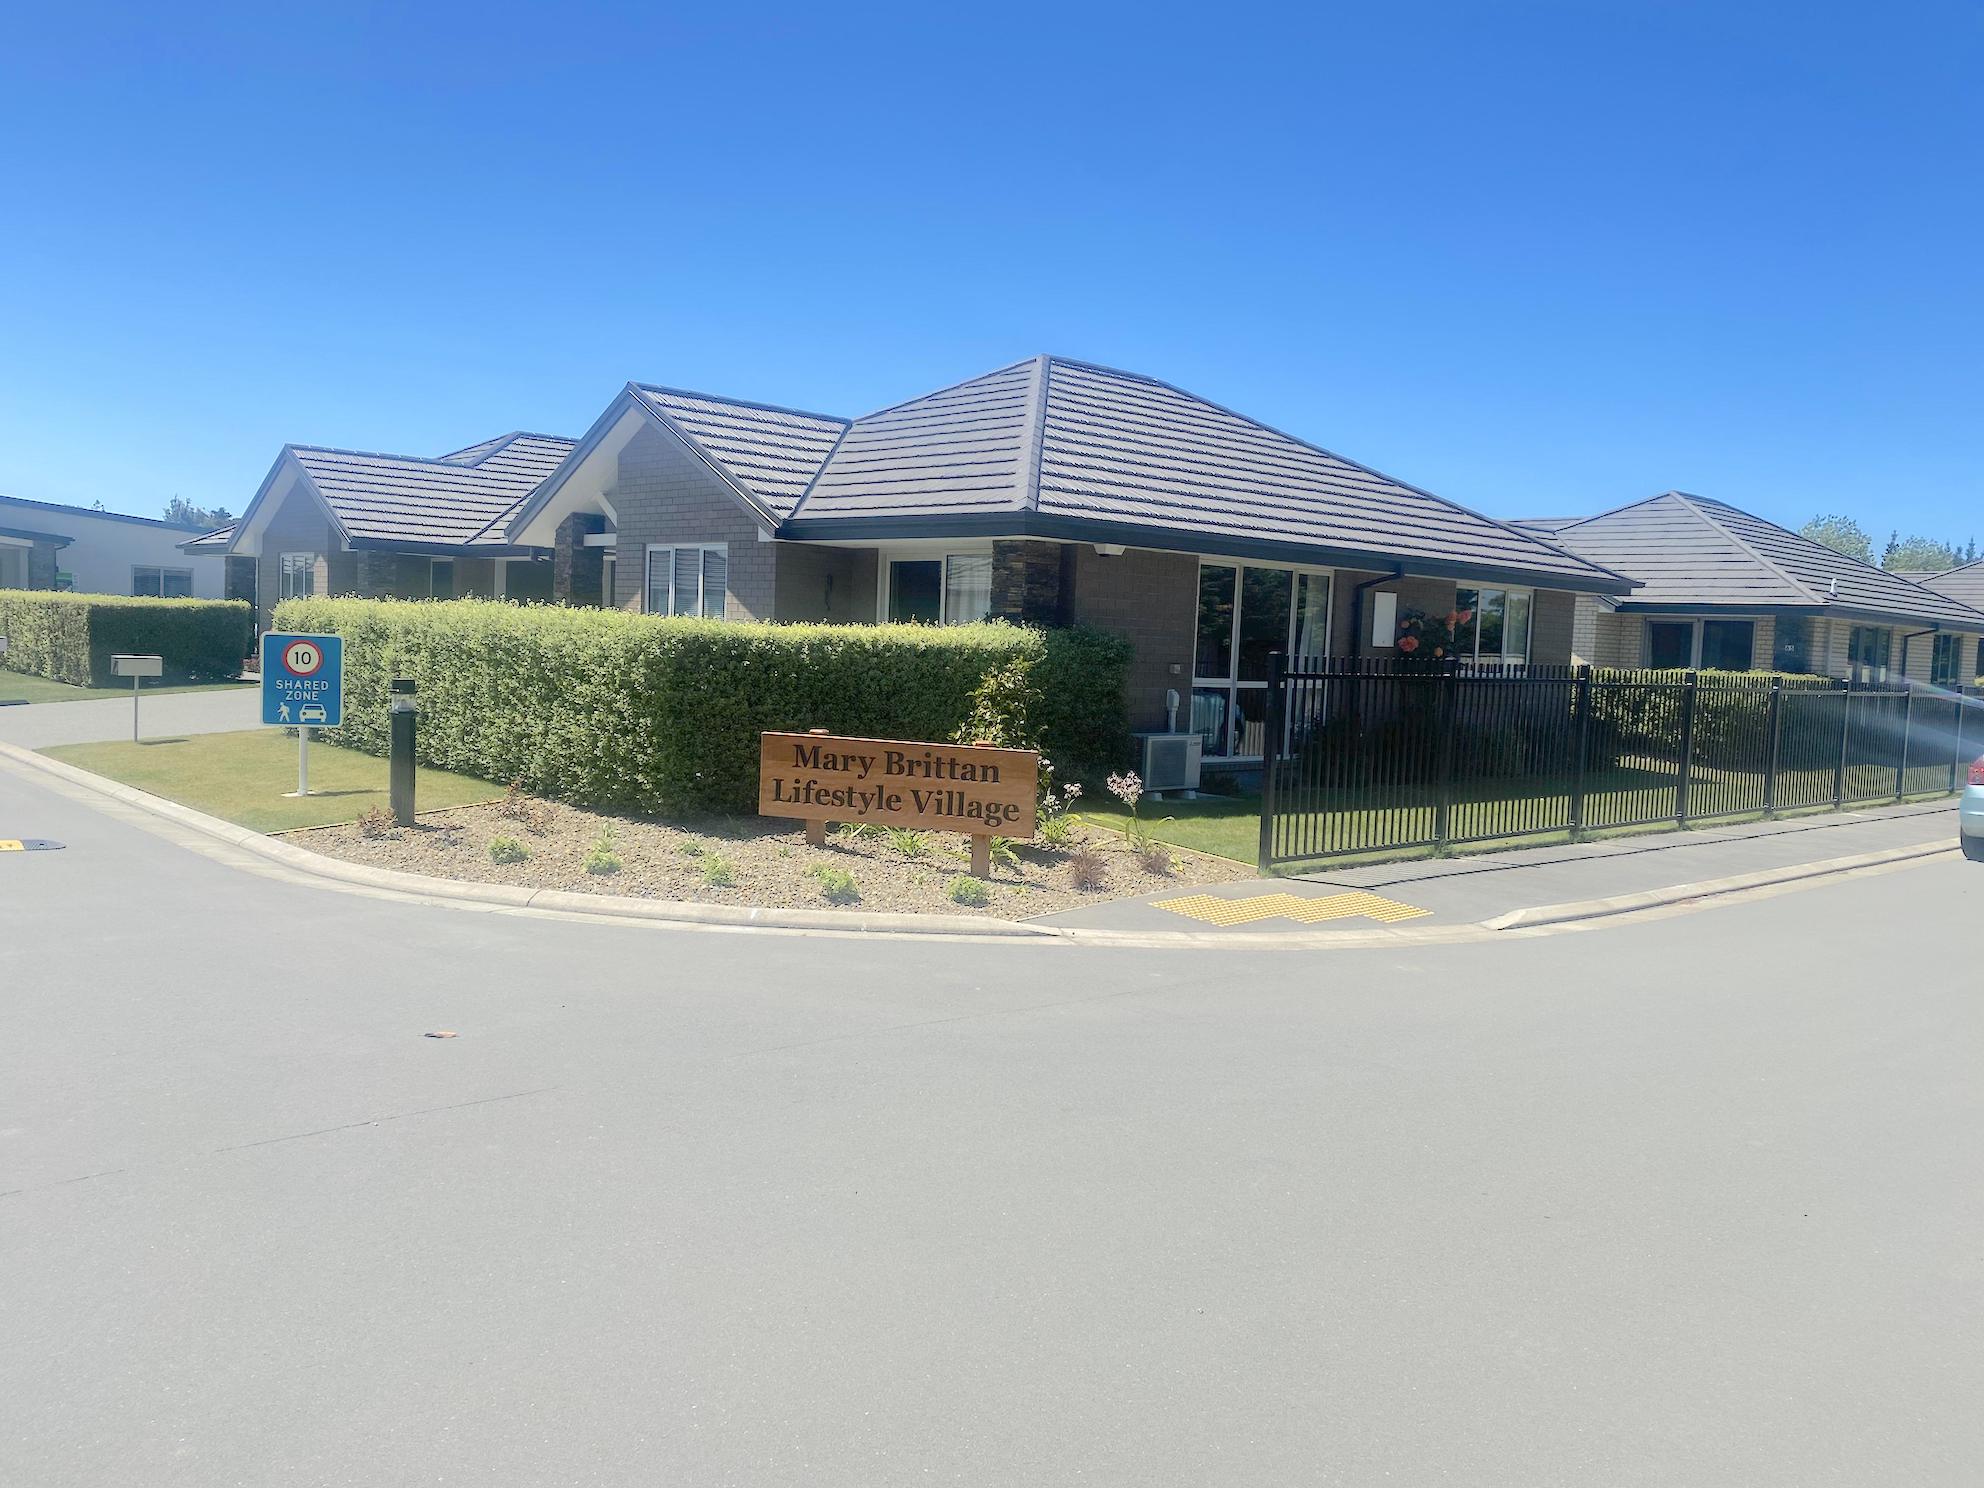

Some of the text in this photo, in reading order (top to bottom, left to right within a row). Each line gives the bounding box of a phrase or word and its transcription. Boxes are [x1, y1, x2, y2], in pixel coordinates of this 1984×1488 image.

[294, 651, 311, 664] 10
[275, 679, 329, 690] SHARED
[285, 690, 319, 701] ZONE
[792, 744, 1000, 783] Mary Brittan
[773, 778, 1020, 828] Lifestyle Village
